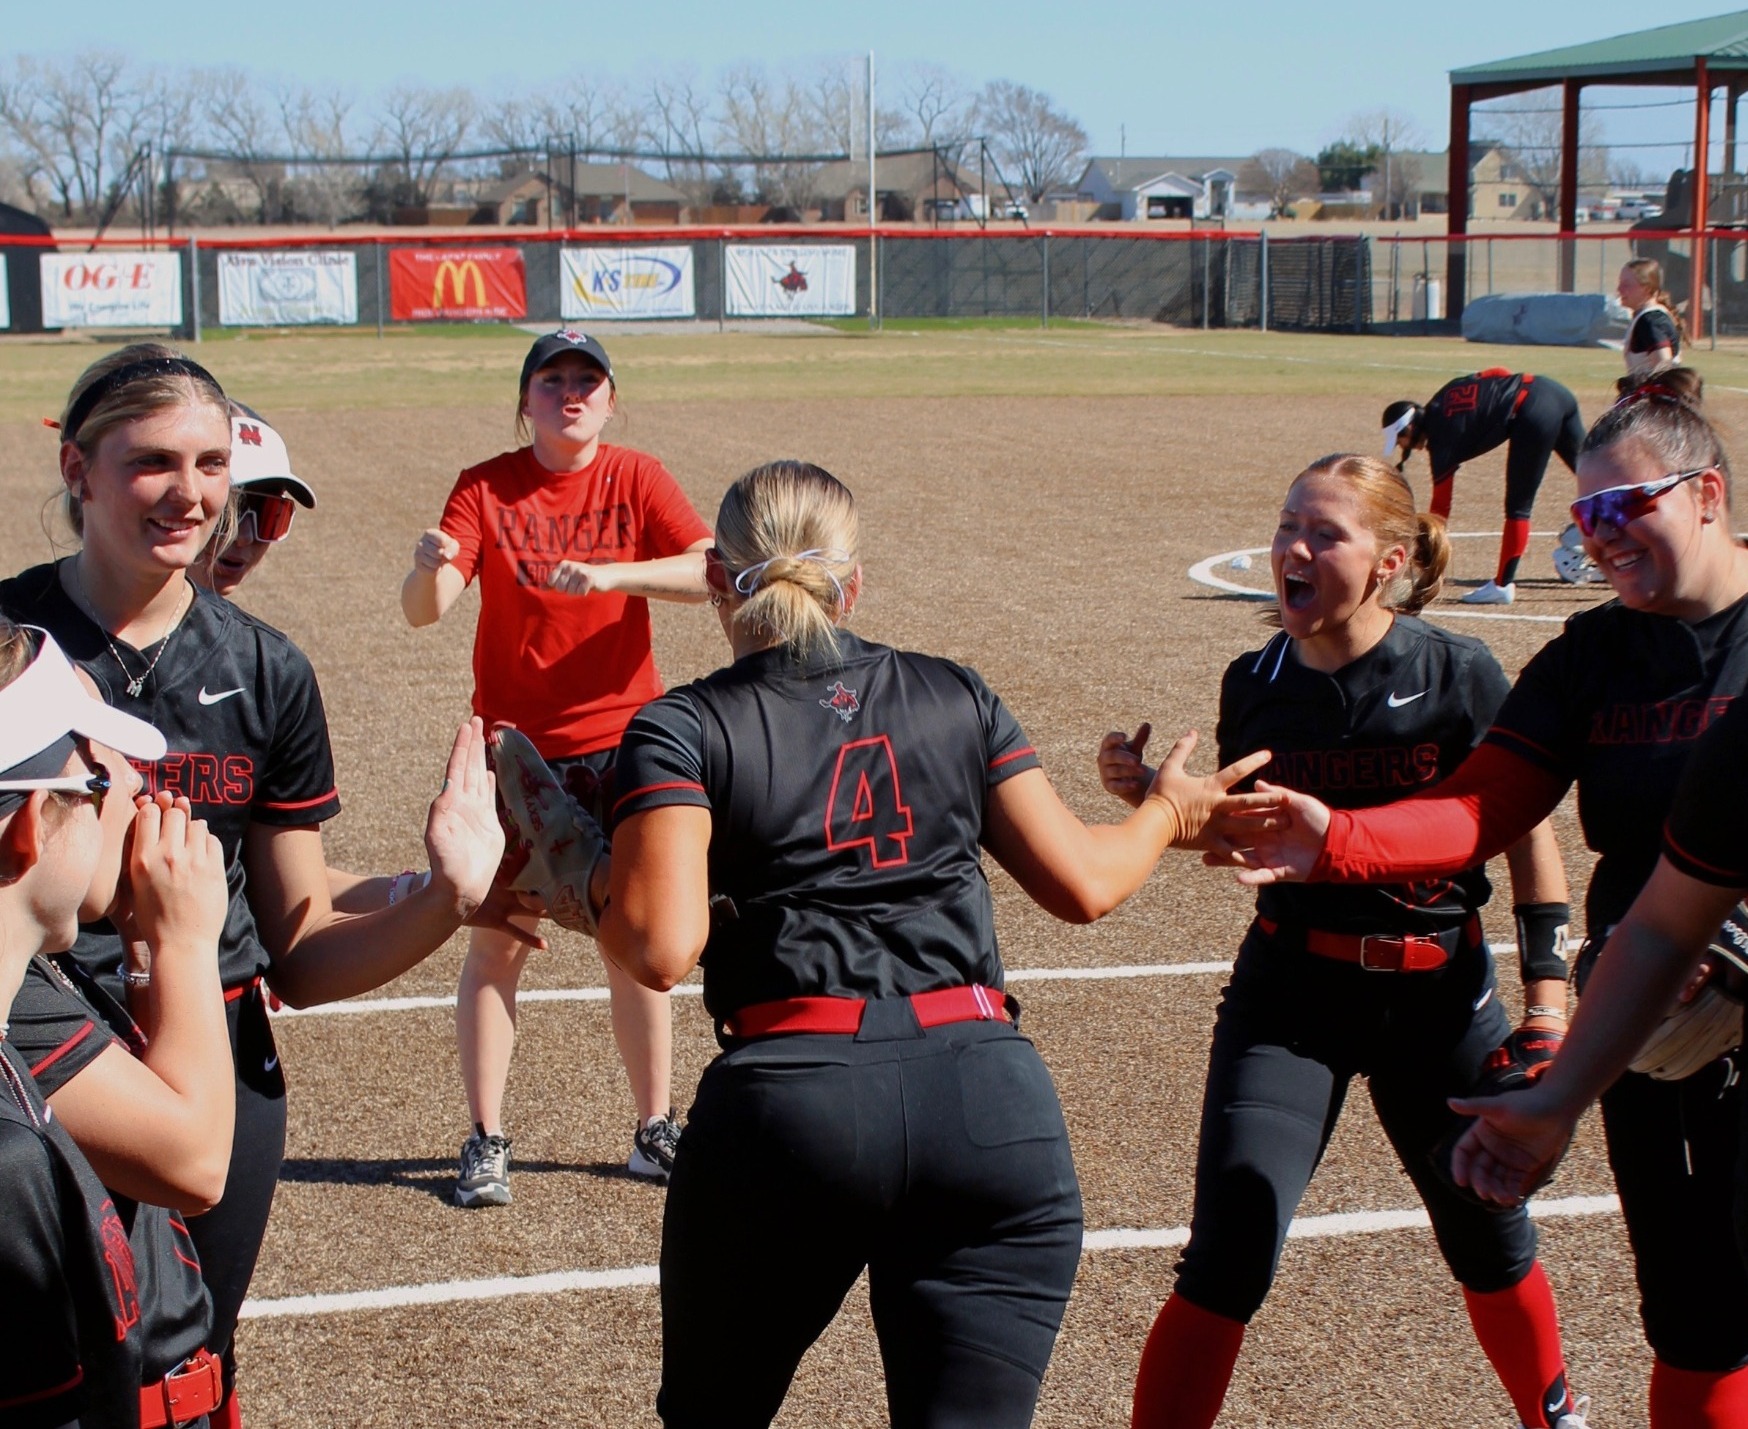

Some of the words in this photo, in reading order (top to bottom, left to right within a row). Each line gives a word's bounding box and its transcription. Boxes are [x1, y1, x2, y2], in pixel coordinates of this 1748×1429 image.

[238, 422, 263, 447] N
[494, 502, 636, 555] RANGER
[1250, 742, 1440, 791] ANGERS
[824, 733, 915, 871] 4
